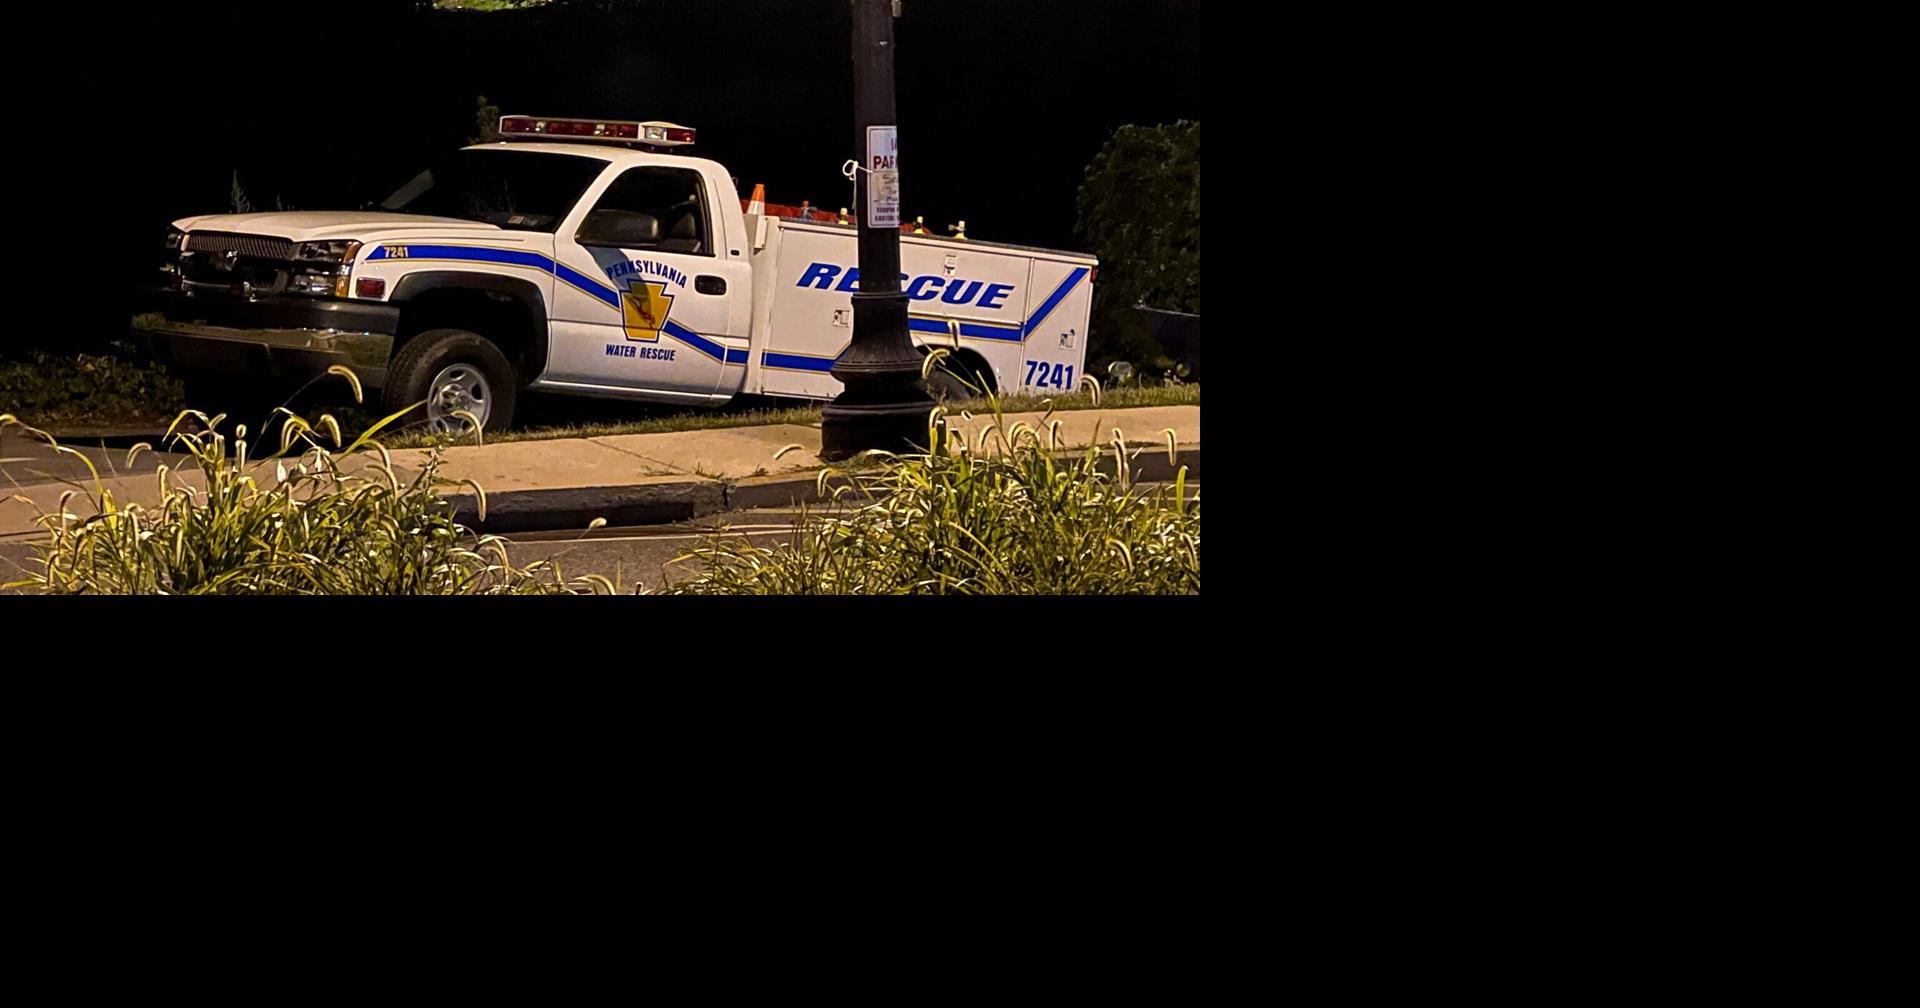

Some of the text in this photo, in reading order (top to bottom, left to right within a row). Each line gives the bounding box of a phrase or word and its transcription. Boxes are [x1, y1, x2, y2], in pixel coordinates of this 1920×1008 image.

[384, 246, 408, 258] 7241
[606, 260, 687, 288] PENNSYLVANIA
[796, 262, 1015, 309] RECUE
[606, 344, 676, 361] WATER RESCUE
[1025, 360, 1073, 390] 7241
